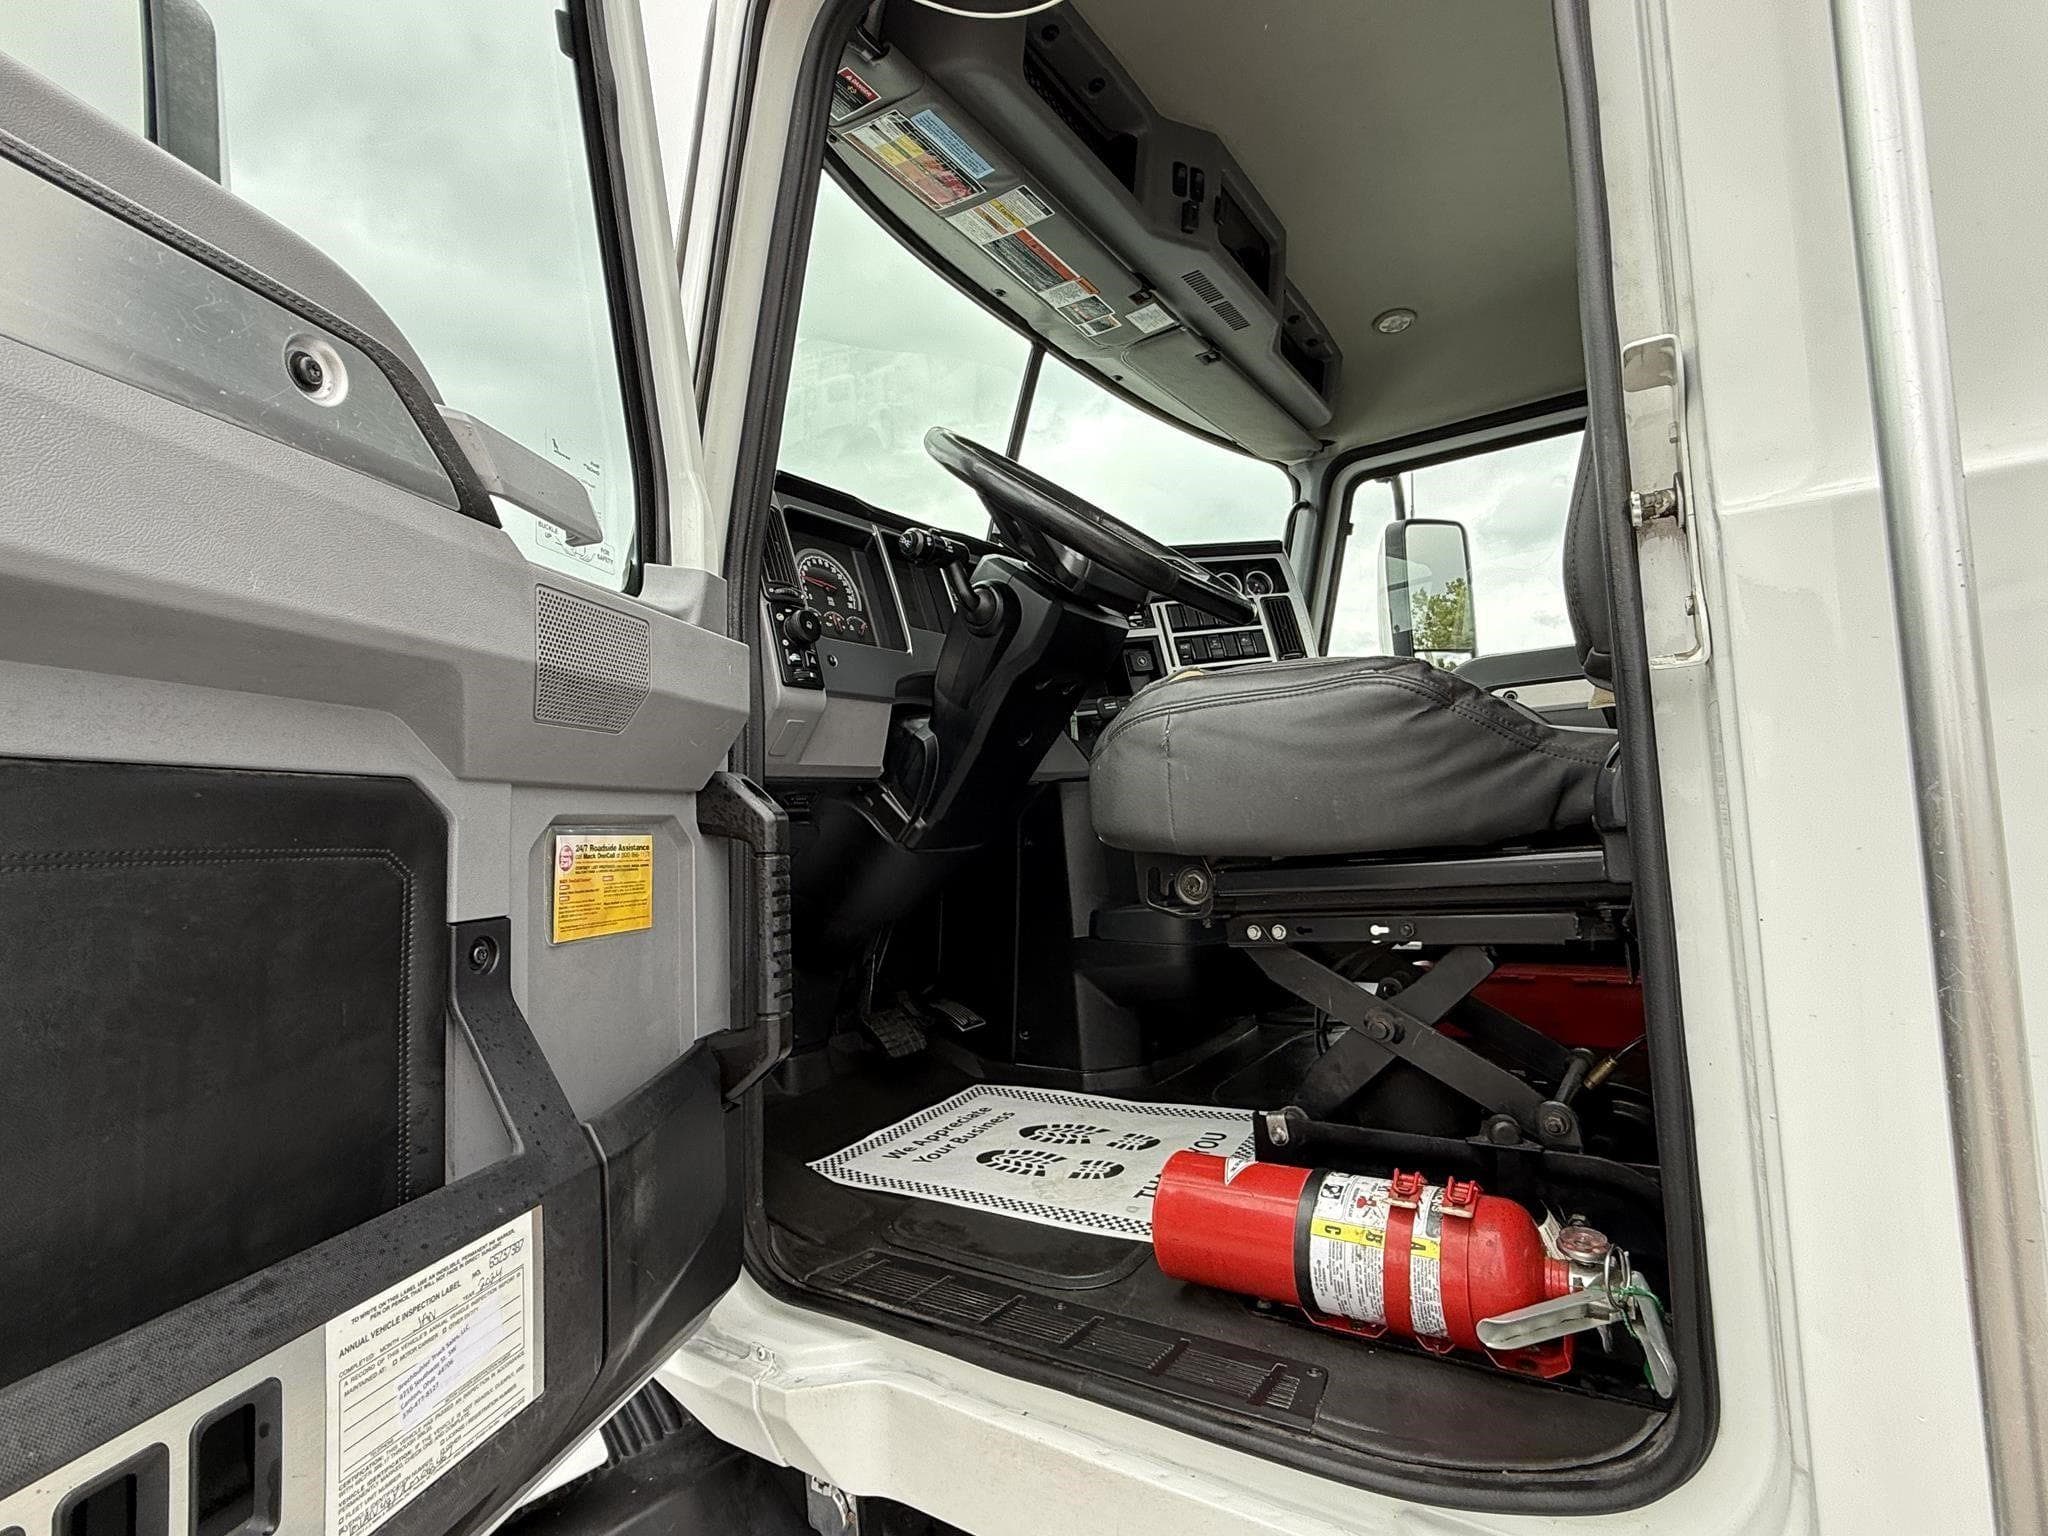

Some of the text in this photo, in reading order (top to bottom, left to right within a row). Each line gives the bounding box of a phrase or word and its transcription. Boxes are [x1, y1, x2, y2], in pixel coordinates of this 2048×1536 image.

[538, 521, 558, 534] BUCKLE
[576, 844, 588, 852] 24/7
[589, 844, 617, 852] Roadside
[882, 1106, 993, 1159] We Appreciate
[911, 1111, 1016, 1163] Your Business
[1187, 1131, 1228, 1154] YOU
[338, 1332, 369, 1359] ANNUAL
[370, 1314, 400, 1340] VEHICLE
[401, 1290, 440, 1322] INSPECTION
[441, 1278, 461, 1297] LABEL
[351, 1315, 359, 1325] TO
[359, 1305, 377, 1320] WRITE
[378, 1299, 386, 1309] ON
[387, 1293, 398, 1305] THIS
[369, 1309, 381, 1321] PEN
[381, 1304, 390, 1314] OR
[379, 1335, 399, 1354] MONTH
[343, 1379, 348, 1388] A
[350, 1362, 375, 1384] RECORD
[376, 1356, 385, 1367] OF
[387, 1347, 399, 1360] THIS
[385, 1442, 397, 1456] THIS
[399, 1425, 421, 1446] VEHICLE
[338, 1483, 364, 1509] VEHICLE
[345, 1501, 362, 1520] FLEET
[364, 1489, 377, 1505] UNIT
[378, 1471, 401, 1495] NUMBER
